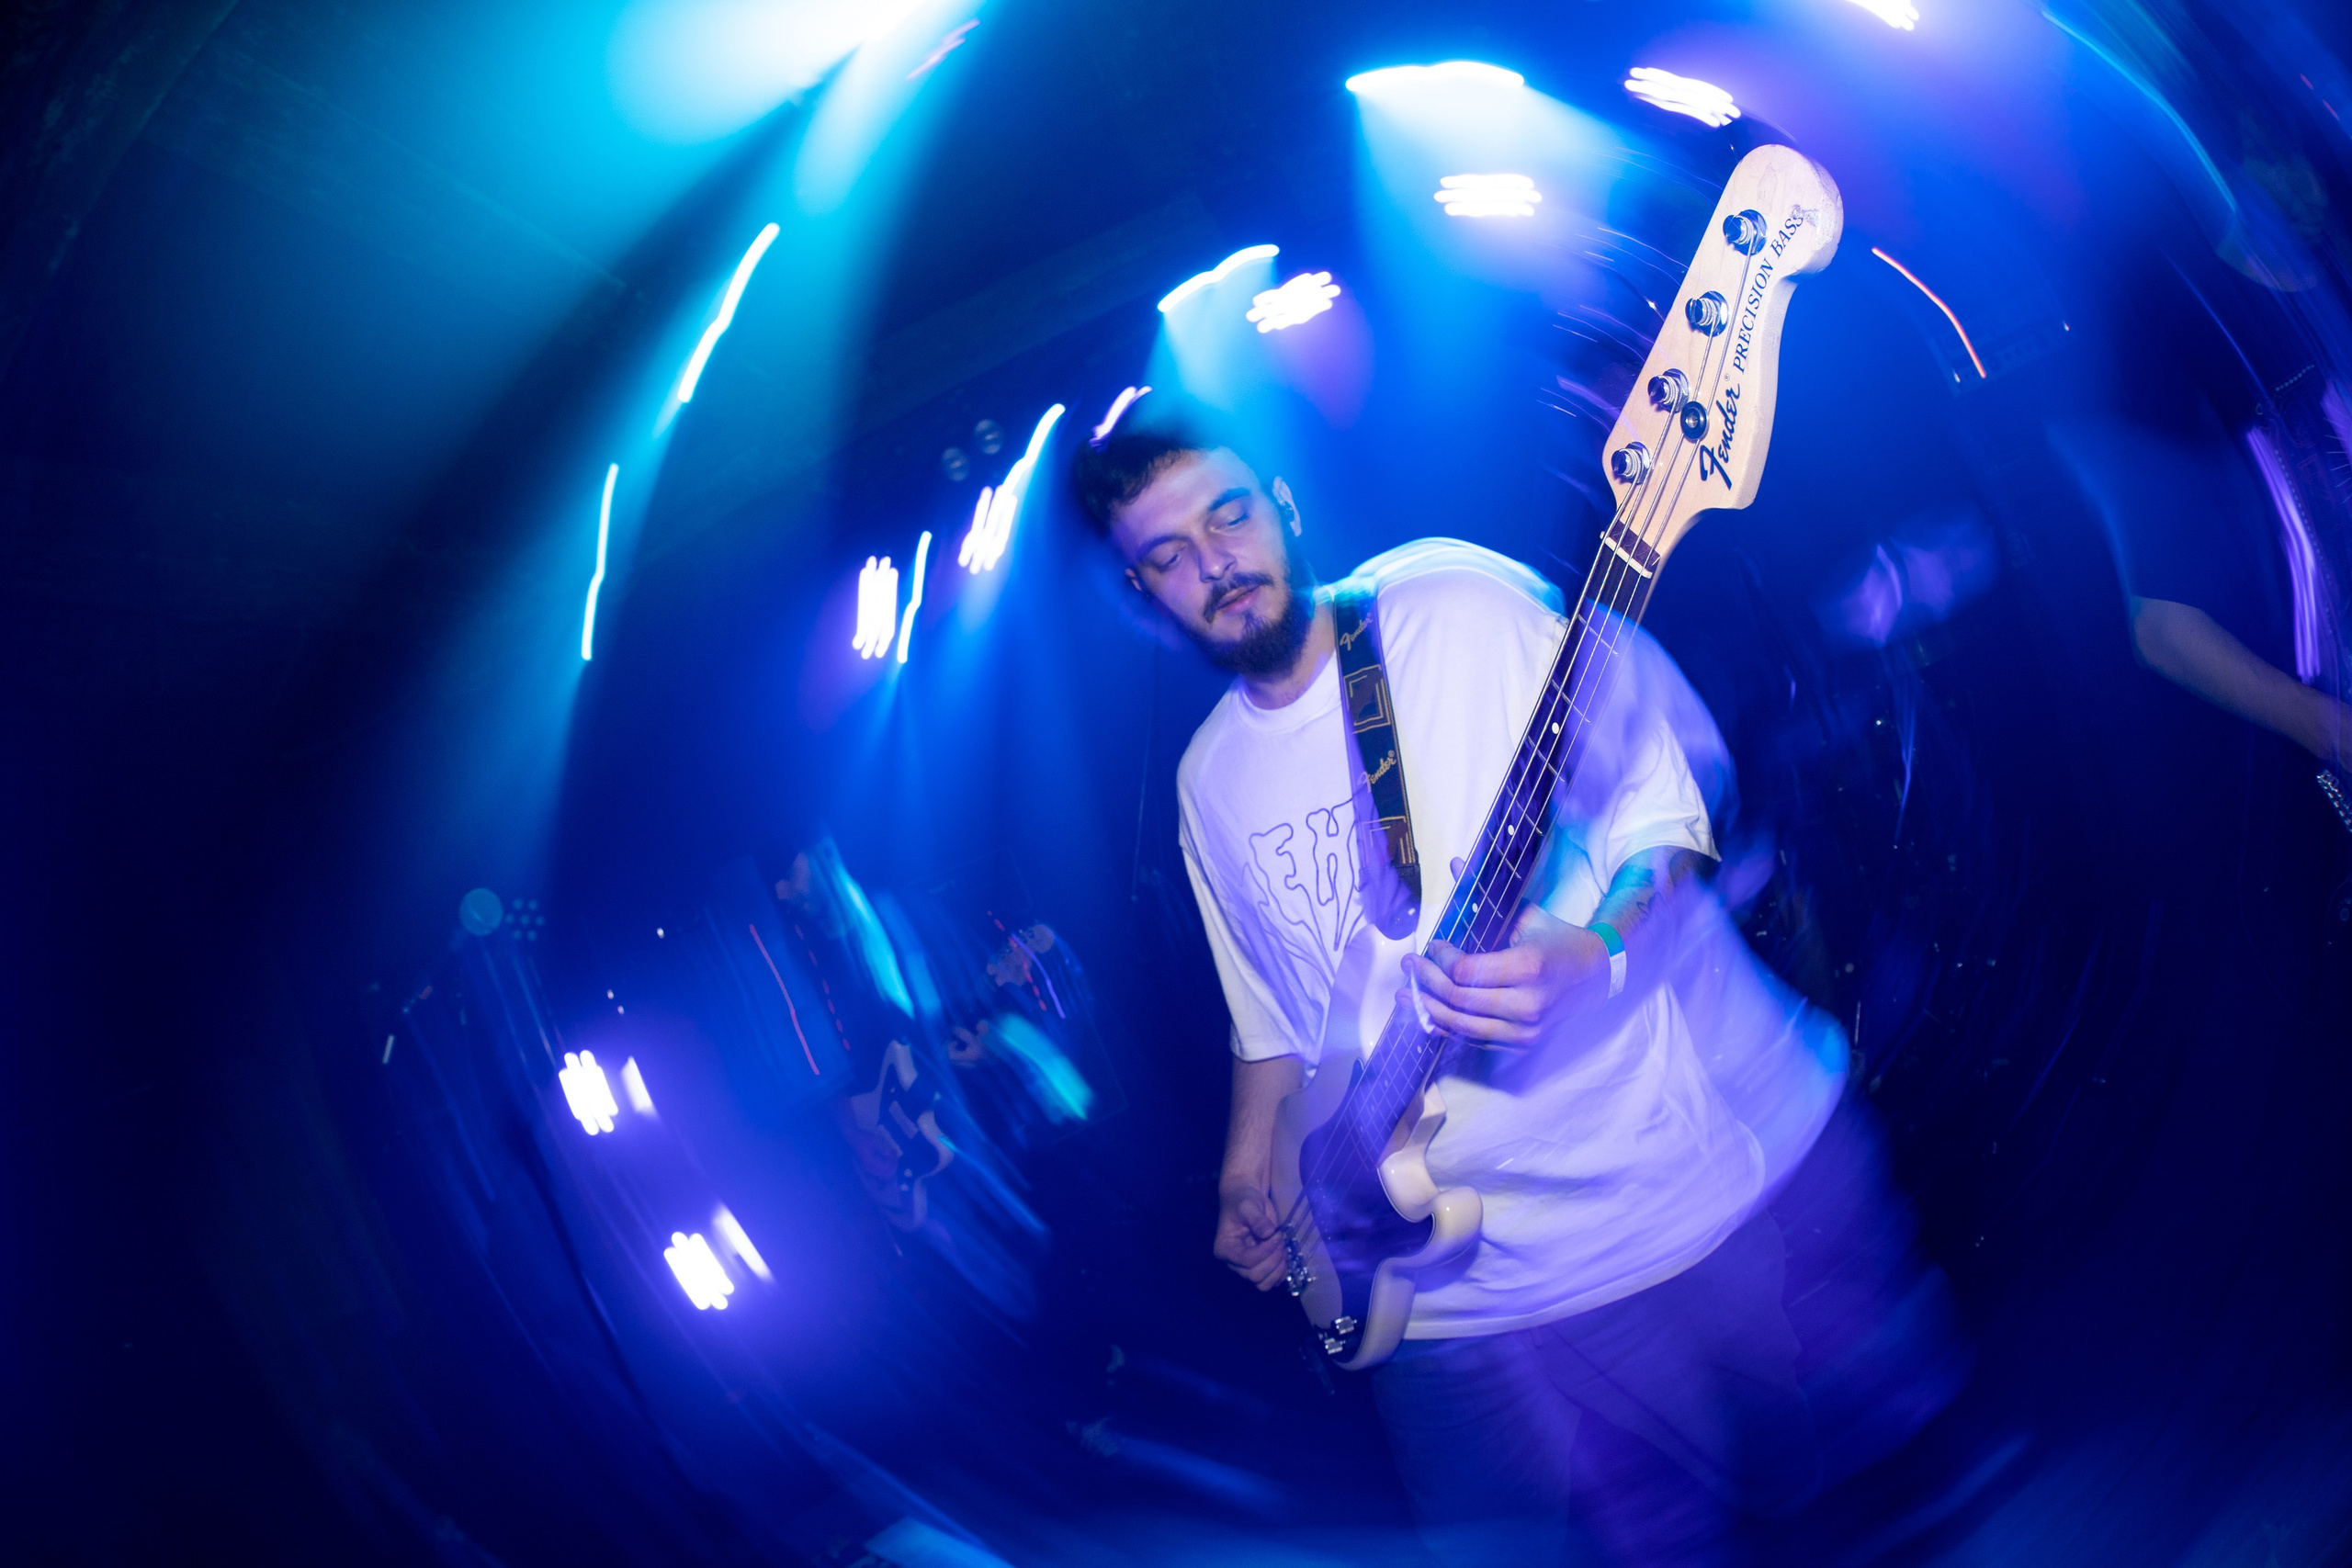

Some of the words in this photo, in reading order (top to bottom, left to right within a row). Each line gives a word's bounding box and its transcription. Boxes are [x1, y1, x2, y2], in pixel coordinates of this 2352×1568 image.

[1733, 258, 1774, 373] PRECISION
[1770, 215, 1804, 258] BASS
[1700, 383, 1740, 491] Fender
[1340, 616, 1373, 651] Fender
[1358, 755, 1396, 794] Fender
